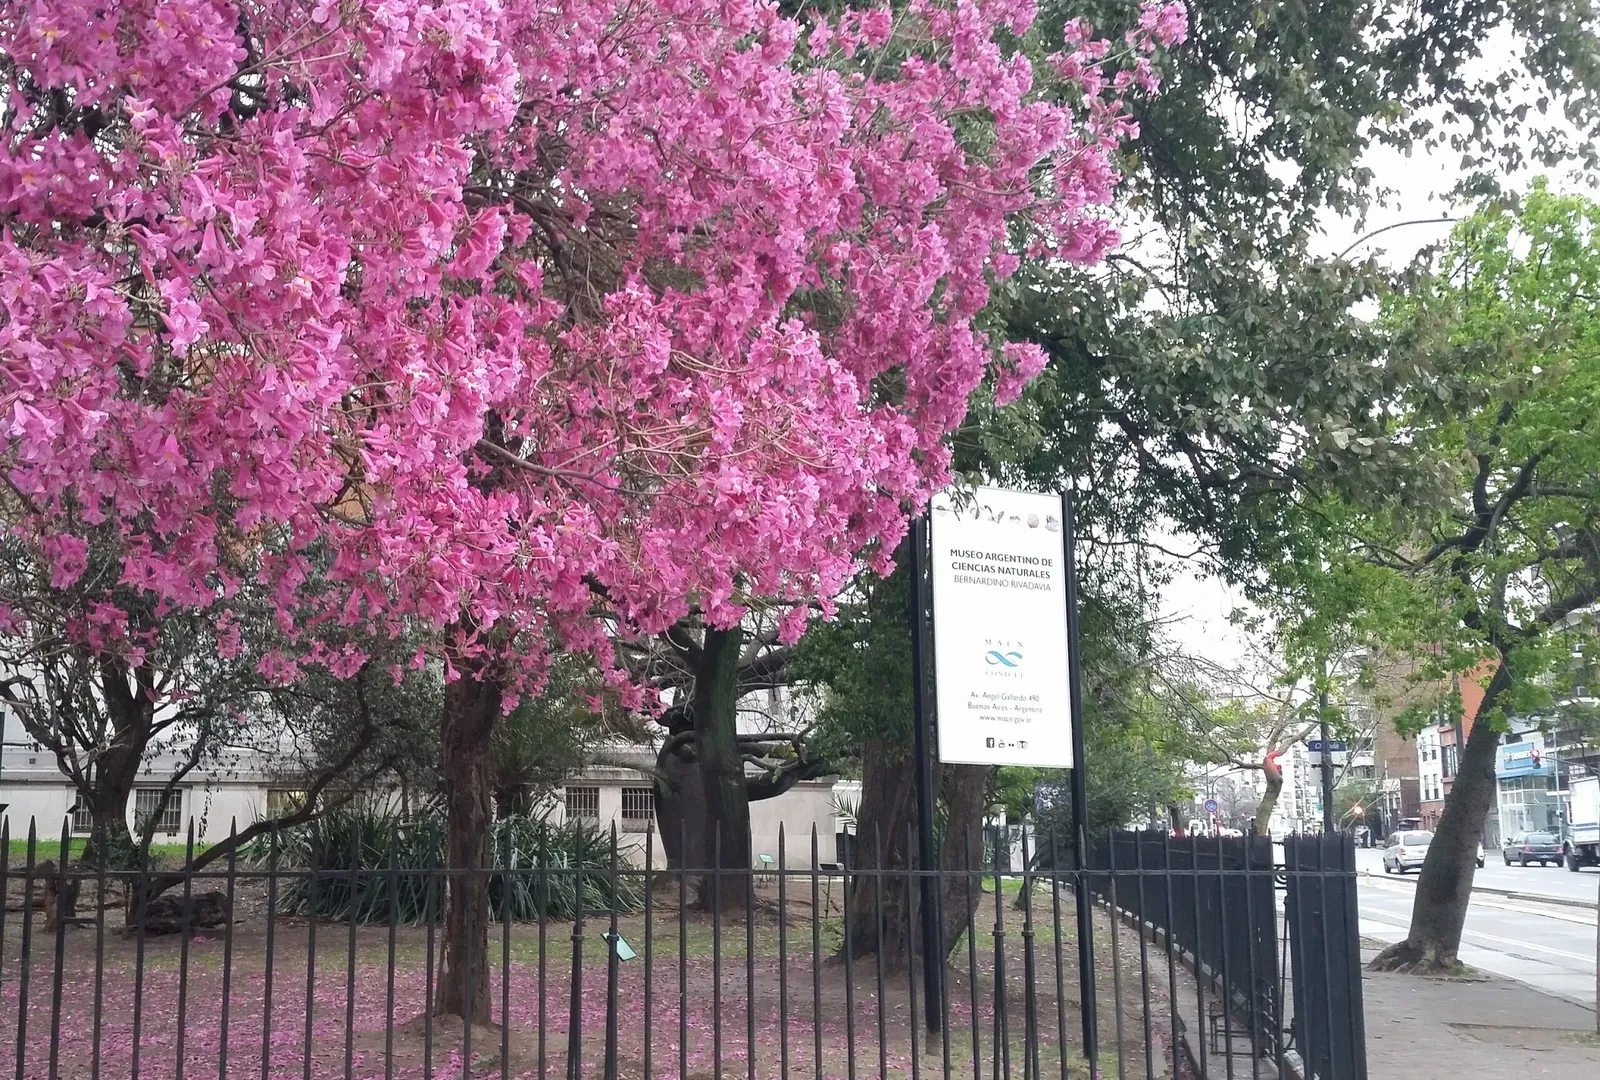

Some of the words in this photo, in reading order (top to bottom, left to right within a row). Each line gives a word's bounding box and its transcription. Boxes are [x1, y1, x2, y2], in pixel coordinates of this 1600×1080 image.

[950, 549, 983, 559] MUSEO
[985, 552, 1039, 565] ARGENTINO
[1041, 558, 1053, 568] DE
[952, 562, 995, 573] CIENCIAS
[997, 566, 1050, 579] NATURALES
[954, 574, 1009, 587] BERNARDINO
[1010, 580, 1051, 591] RIVADAVIA
[1001, 692, 1027, 702] Gallardo
[967, 702, 990, 710] Buenos
[992, 703, 1008, 712] Aires
[1015, 705, 1043, 714] Argentina
